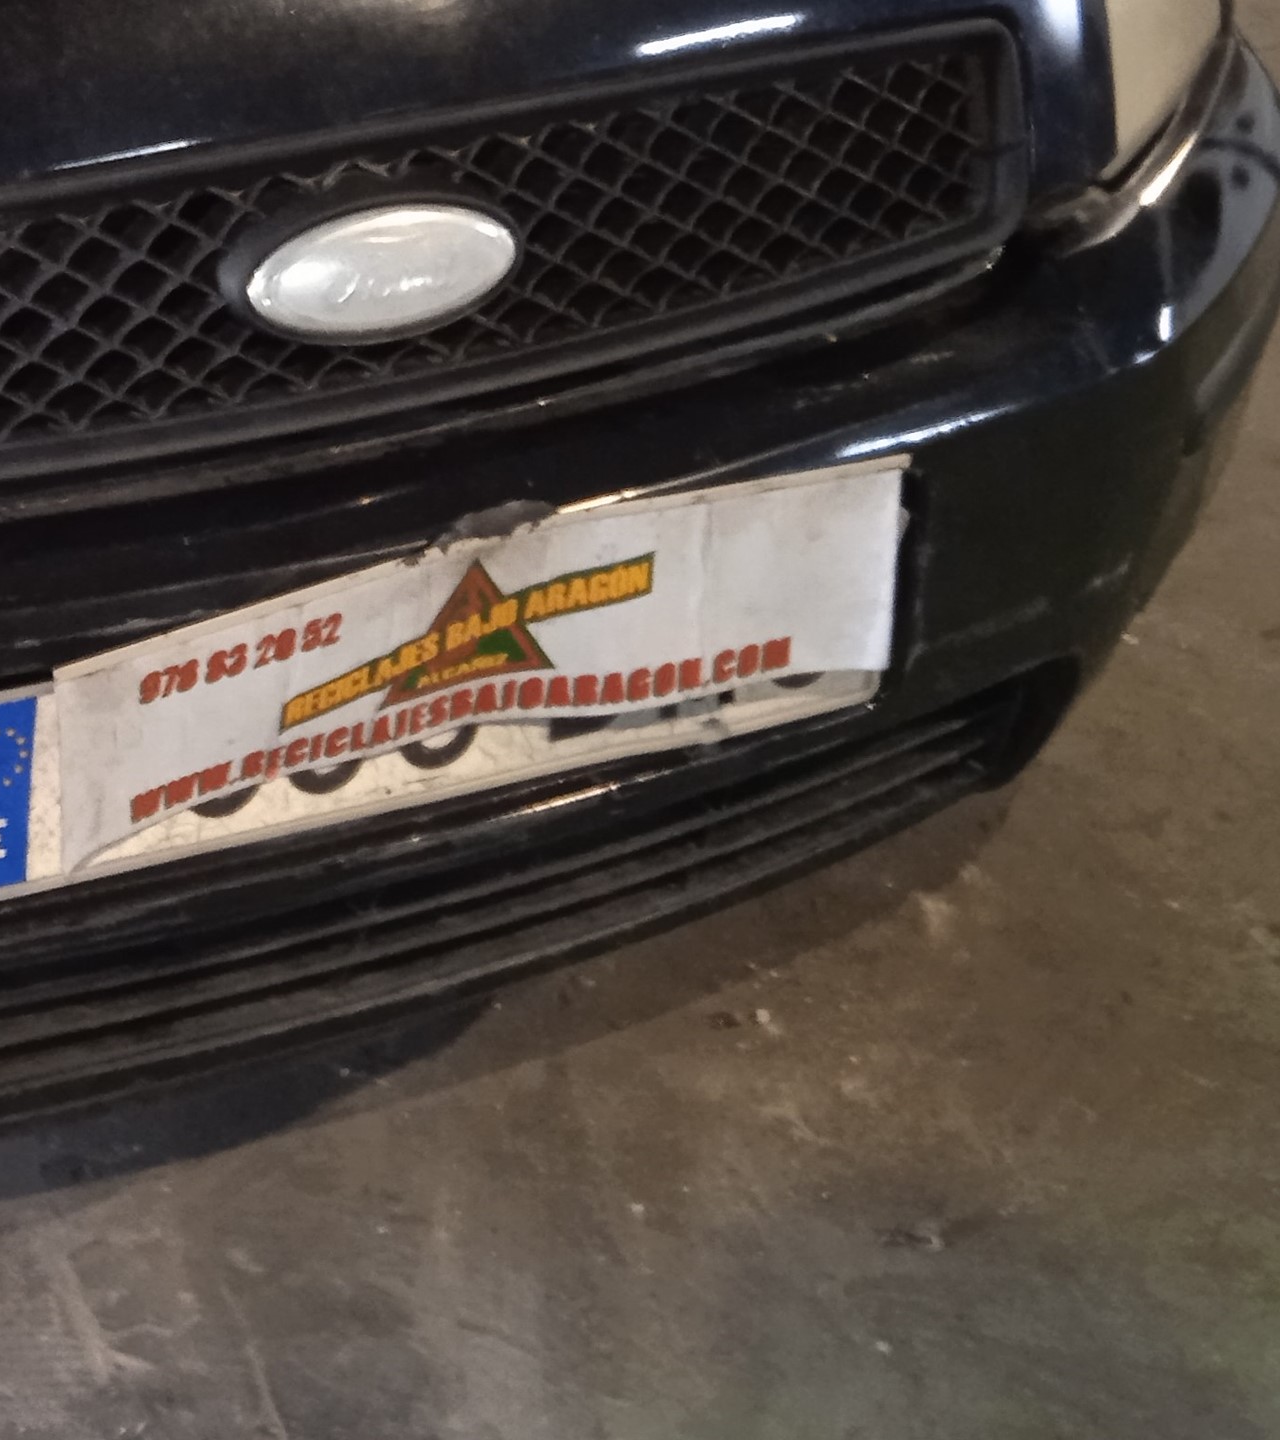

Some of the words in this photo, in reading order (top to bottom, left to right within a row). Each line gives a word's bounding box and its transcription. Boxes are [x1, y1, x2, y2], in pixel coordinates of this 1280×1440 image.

[283, 631, 440, 726] RECICLAJES
[444, 595, 520, 651] BAJO
[300, 612, 343, 653] 52
